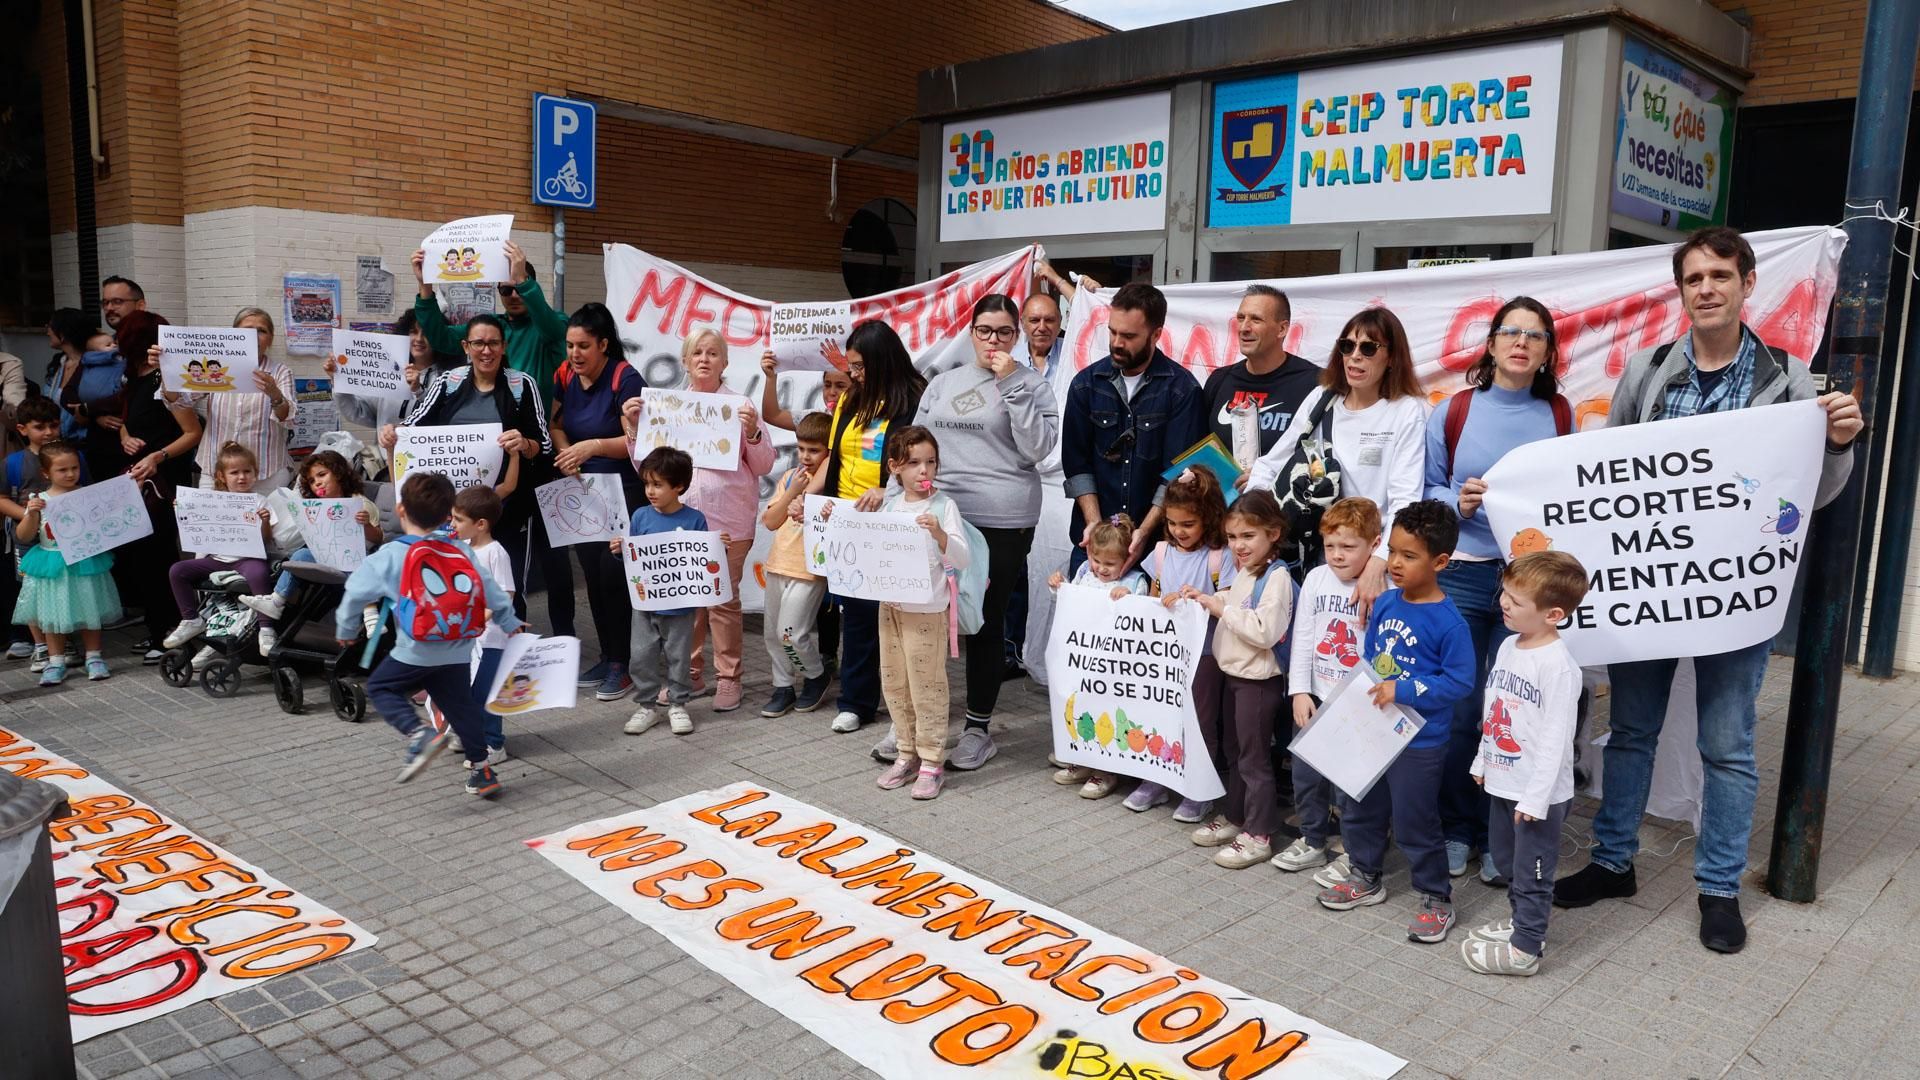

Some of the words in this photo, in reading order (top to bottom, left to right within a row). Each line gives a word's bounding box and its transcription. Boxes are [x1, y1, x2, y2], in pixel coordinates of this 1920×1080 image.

[1301, 92, 1385, 137] CEIP
[1397, 75, 1532, 128] TORRE
[553, 106, 579, 146] P
[1674, 101, 1705, 147] ¿qué
[949, 129, 994, 187] 30
[996, 151, 1050, 183] AÑOS
[1056, 140, 1164, 176] ABRIENDO
[1300, 133, 1526, 188] MALMUERTA
[948, 190, 978, 215] LAS
[982, 183, 1056, 212] PUERTAS
[1060, 180, 1084, 204] AL
[1087, 173, 1162, 202] FUTURO
[1622, 172, 1636, 191] VII
[1636, 178, 1660, 200] Semana
[1661, 187, 1669, 203] de
[1670, 190, 1677, 206] la
[1678, 196, 1712, 214] capacidad
[772, 322, 808, 335] SOMOS
[811, 320, 845, 335] NIÑOS
[165, 347, 223, 355] ALIMENTACIÓN
[353, 340, 382, 350] MENOS
[340, 367, 402, 381] ALIMENTACIÓN
[361, 359, 379, 368] MÁS
[361, 379, 397, 390] CALIDAD
[935, 420, 945, 428] EL
[946, 421, 984, 430] CARMEN
[410, 434, 453, 444] COMER
[457, 433, 484, 443] BIEN
[431, 446, 445, 454] ES
[448, 446, 465, 454] UN
[418, 456, 479, 467] DERECHO,
[452, 468, 468, 477] UN
[1576, 448, 1713, 488] MENOS
[1543, 482, 1751, 527] RECORTES,
[1611, 521, 1694, 555] MÁS
[642, 556, 687, 571] NIÑOS
[691, 556, 709, 567] NO
[829, 540, 856, 565] NO
[880, 560, 894, 568] DE
[651, 571, 681, 584] SON
[686, 570, 704, 581] UN
[1587, 542, 1799, 593] MENTACIÓN
[1608, 584, 1778, 626] CALIDAD
[1115, 615, 1144, 632] CON
[1152, 619, 1176, 635] LA
[1378, 618, 1418, 647] ADIDAS
[1068, 652, 1160, 679] NUESTROS
[1081, 678, 1107, 695] NO
[1113, 682, 1136, 699] SE
[49, 794, 356, 978] BENEFICIO
[566, 825, 686, 872] NO
[632, 859, 763, 911] ES
[715, 897, 855, 960] UN
[800, 938, 1041, 1066] LUJO
[689, 790, 772, 838] LA
[776, 822, 1308, 1080] ALIMENTACIÓN
